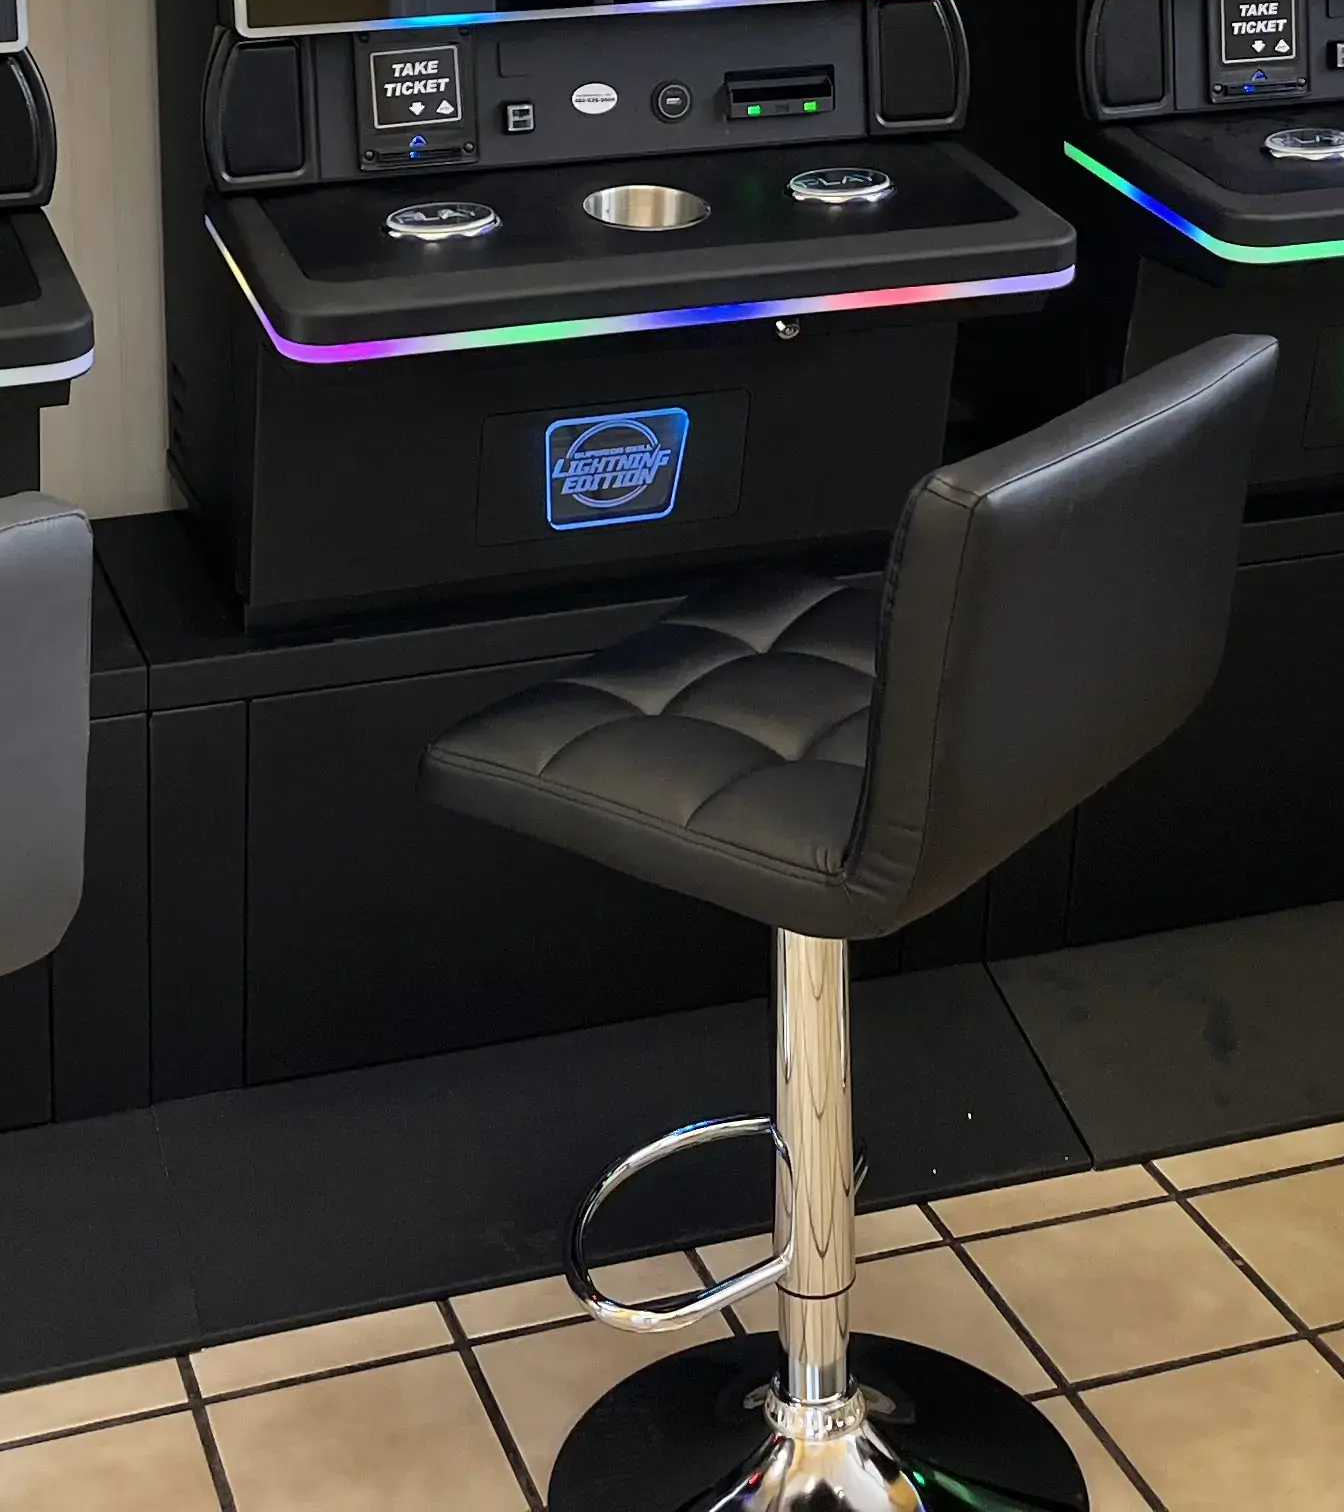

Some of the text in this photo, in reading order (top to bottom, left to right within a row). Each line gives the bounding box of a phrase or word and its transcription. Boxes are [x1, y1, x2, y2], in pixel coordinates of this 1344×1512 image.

[1239, 2, 1279, 18] TAKE
[1232, 18, 1287, 36] TICKET
[392, 60, 439, 78] TAKE
[384, 78, 449, 97] TICKET
[552, 444, 672, 479] LIGHTNING
[561, 467, 658, 495] EDITION
